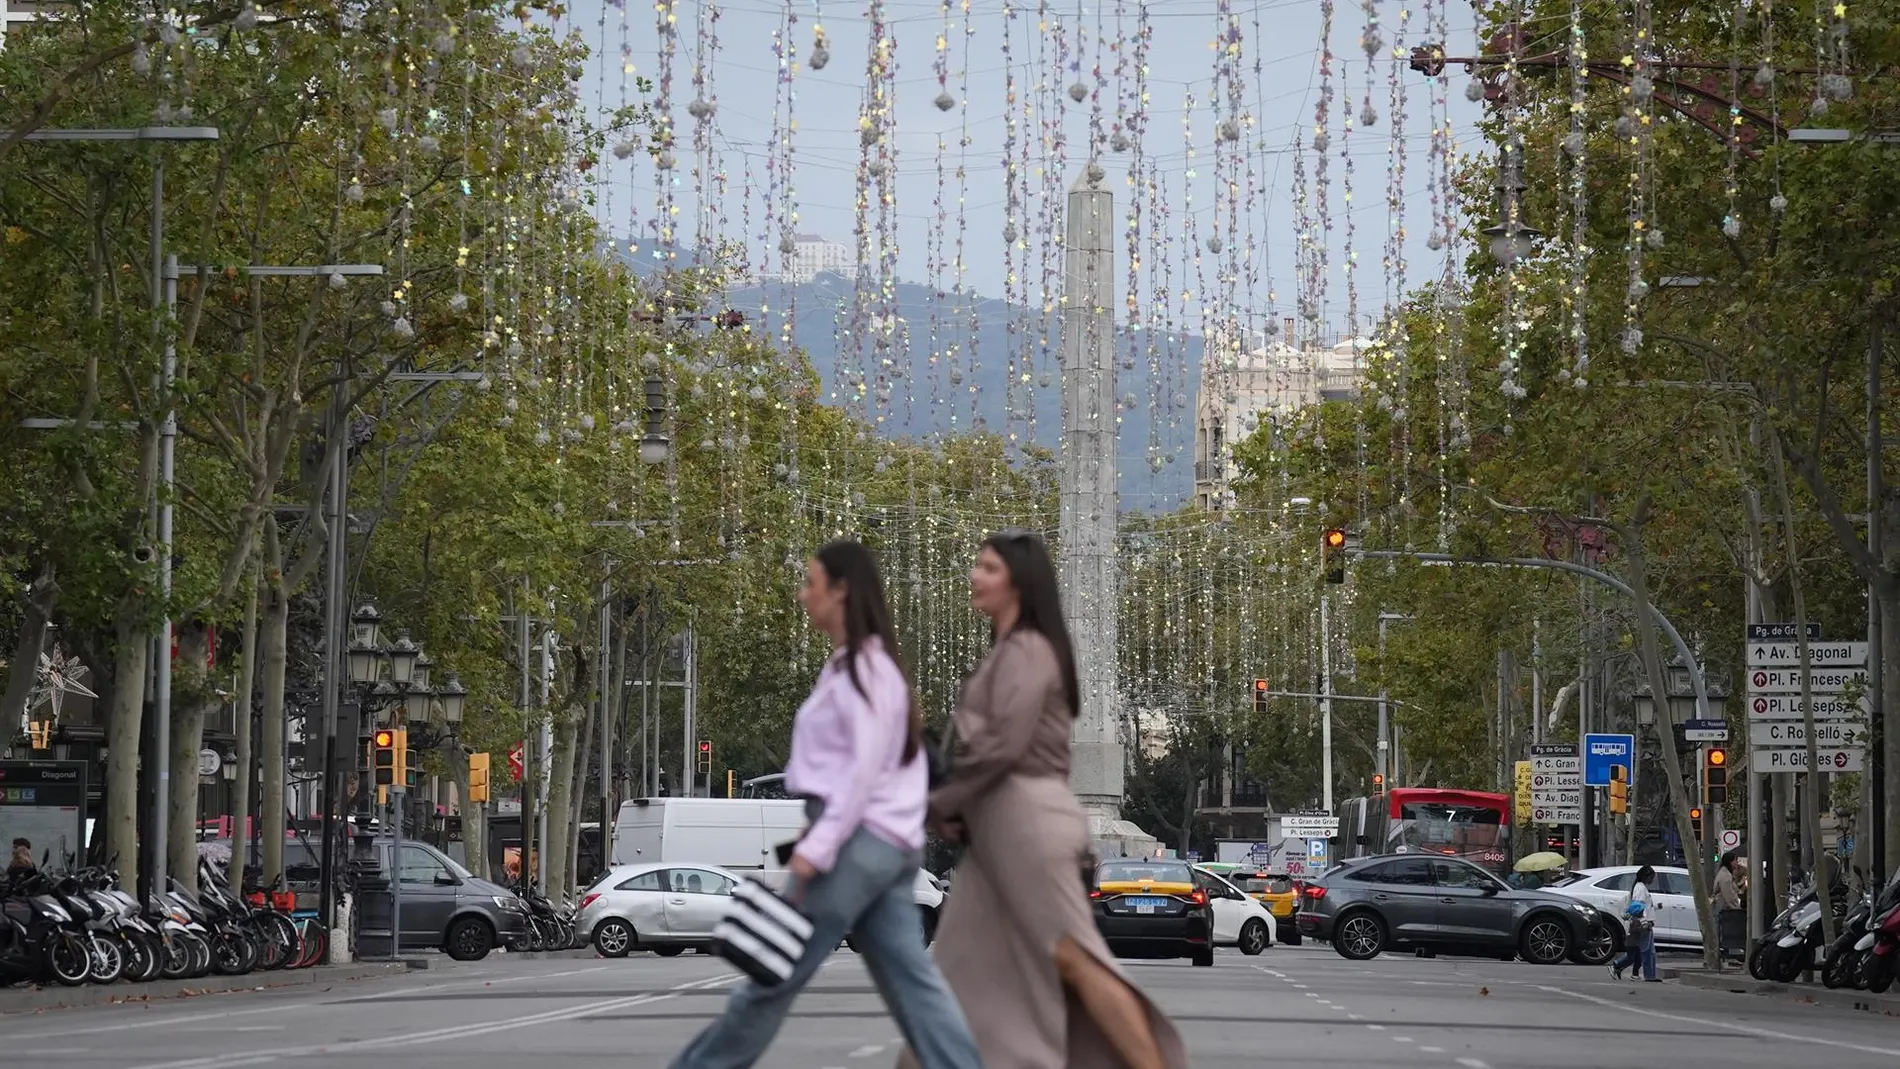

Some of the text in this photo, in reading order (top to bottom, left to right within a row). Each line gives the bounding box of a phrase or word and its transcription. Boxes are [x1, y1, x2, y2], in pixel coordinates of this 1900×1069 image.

[1755, 626, 1812, 637] Pg. de Gràa
[1770, 645, 1852, 662] Av. Dagonal
[1769, 673, 1785, 686] Pl.
[1790, 673, 1849, 686] Frncesc
[1769, 699, 1843, 714] Pl. Leseps
[1770, 726, 1840, 739] C. Roselló
[1544, 760, 1576, 768] C. Gran
[1772, 752, 1832, 766] Pl. Glòes
[41, 771, 77, 779] Diagonal
[1544, 777, 1580, 785] Pl. Lesse
[1545, 793, 1558, 803] Av.
[1560, 793, 1579, 805] Diag
[1446, 810, 1456, 822] 7
[1545, 811, 1580, 819] Pl. Franc
[1484, 853, 1505, 861] 8405
